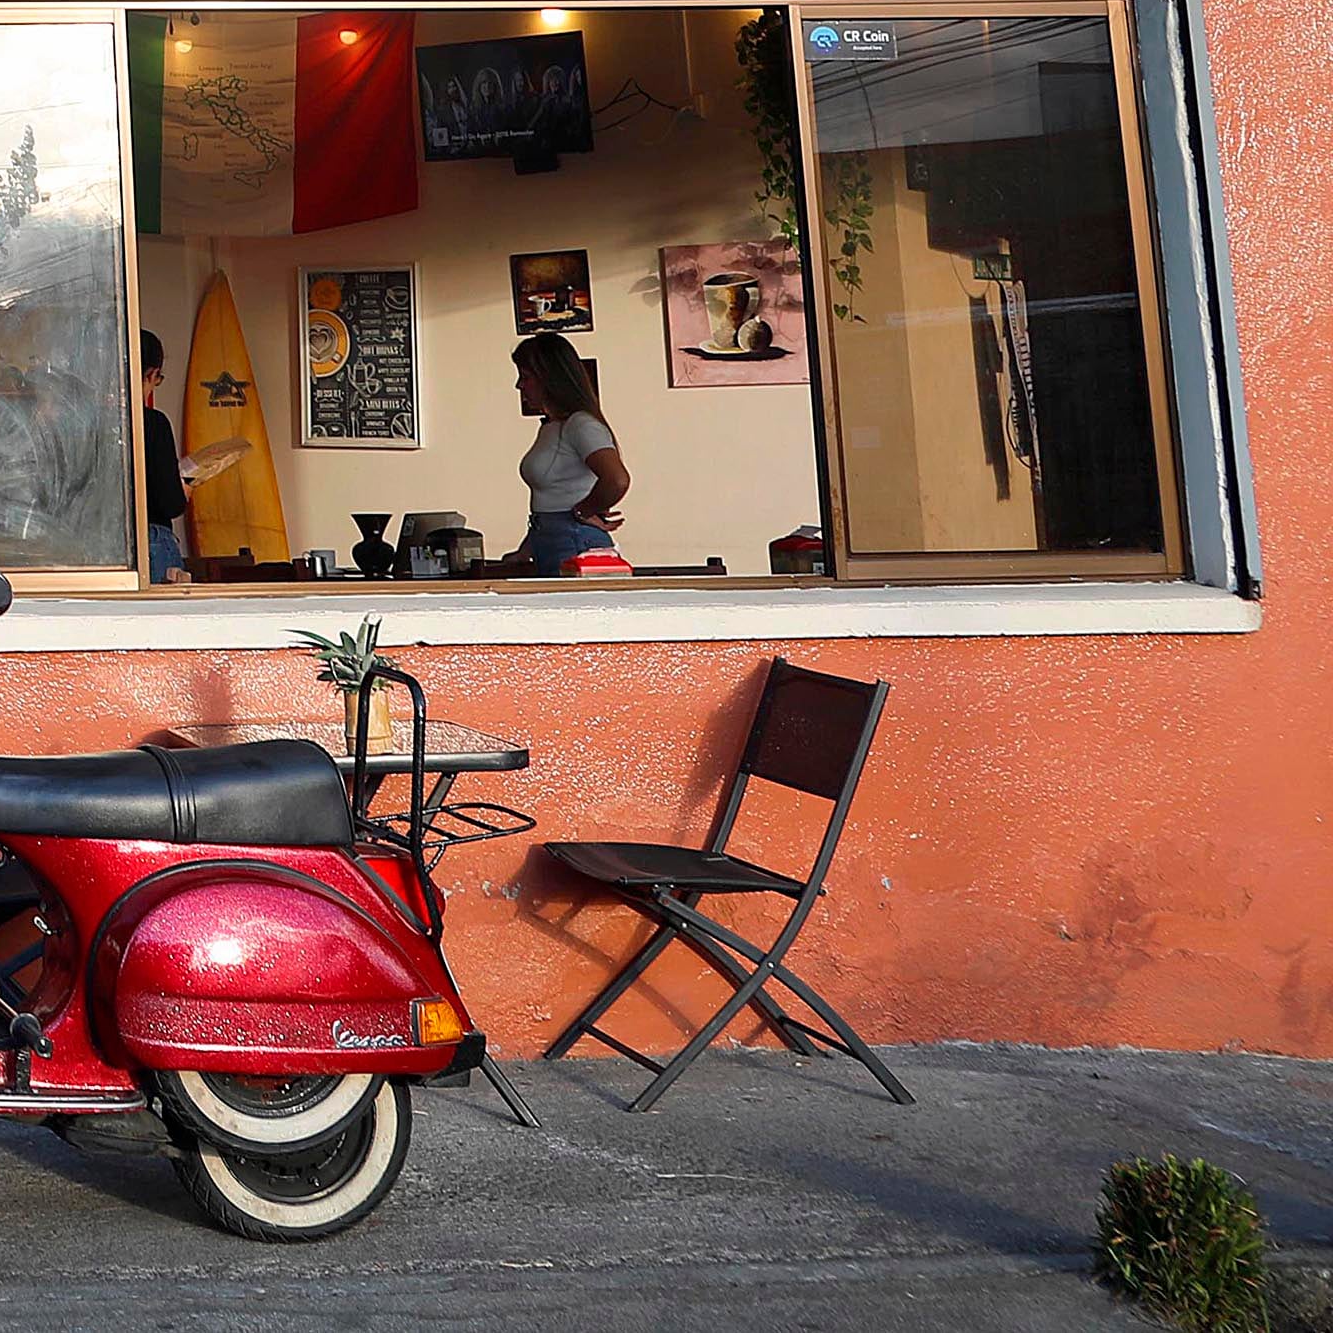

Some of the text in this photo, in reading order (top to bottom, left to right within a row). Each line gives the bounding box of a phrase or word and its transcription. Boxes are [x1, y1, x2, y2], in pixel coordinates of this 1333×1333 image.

[843, 29, 890, 42] CR Coin
[332, 1020, 407, 1048] Vespa
